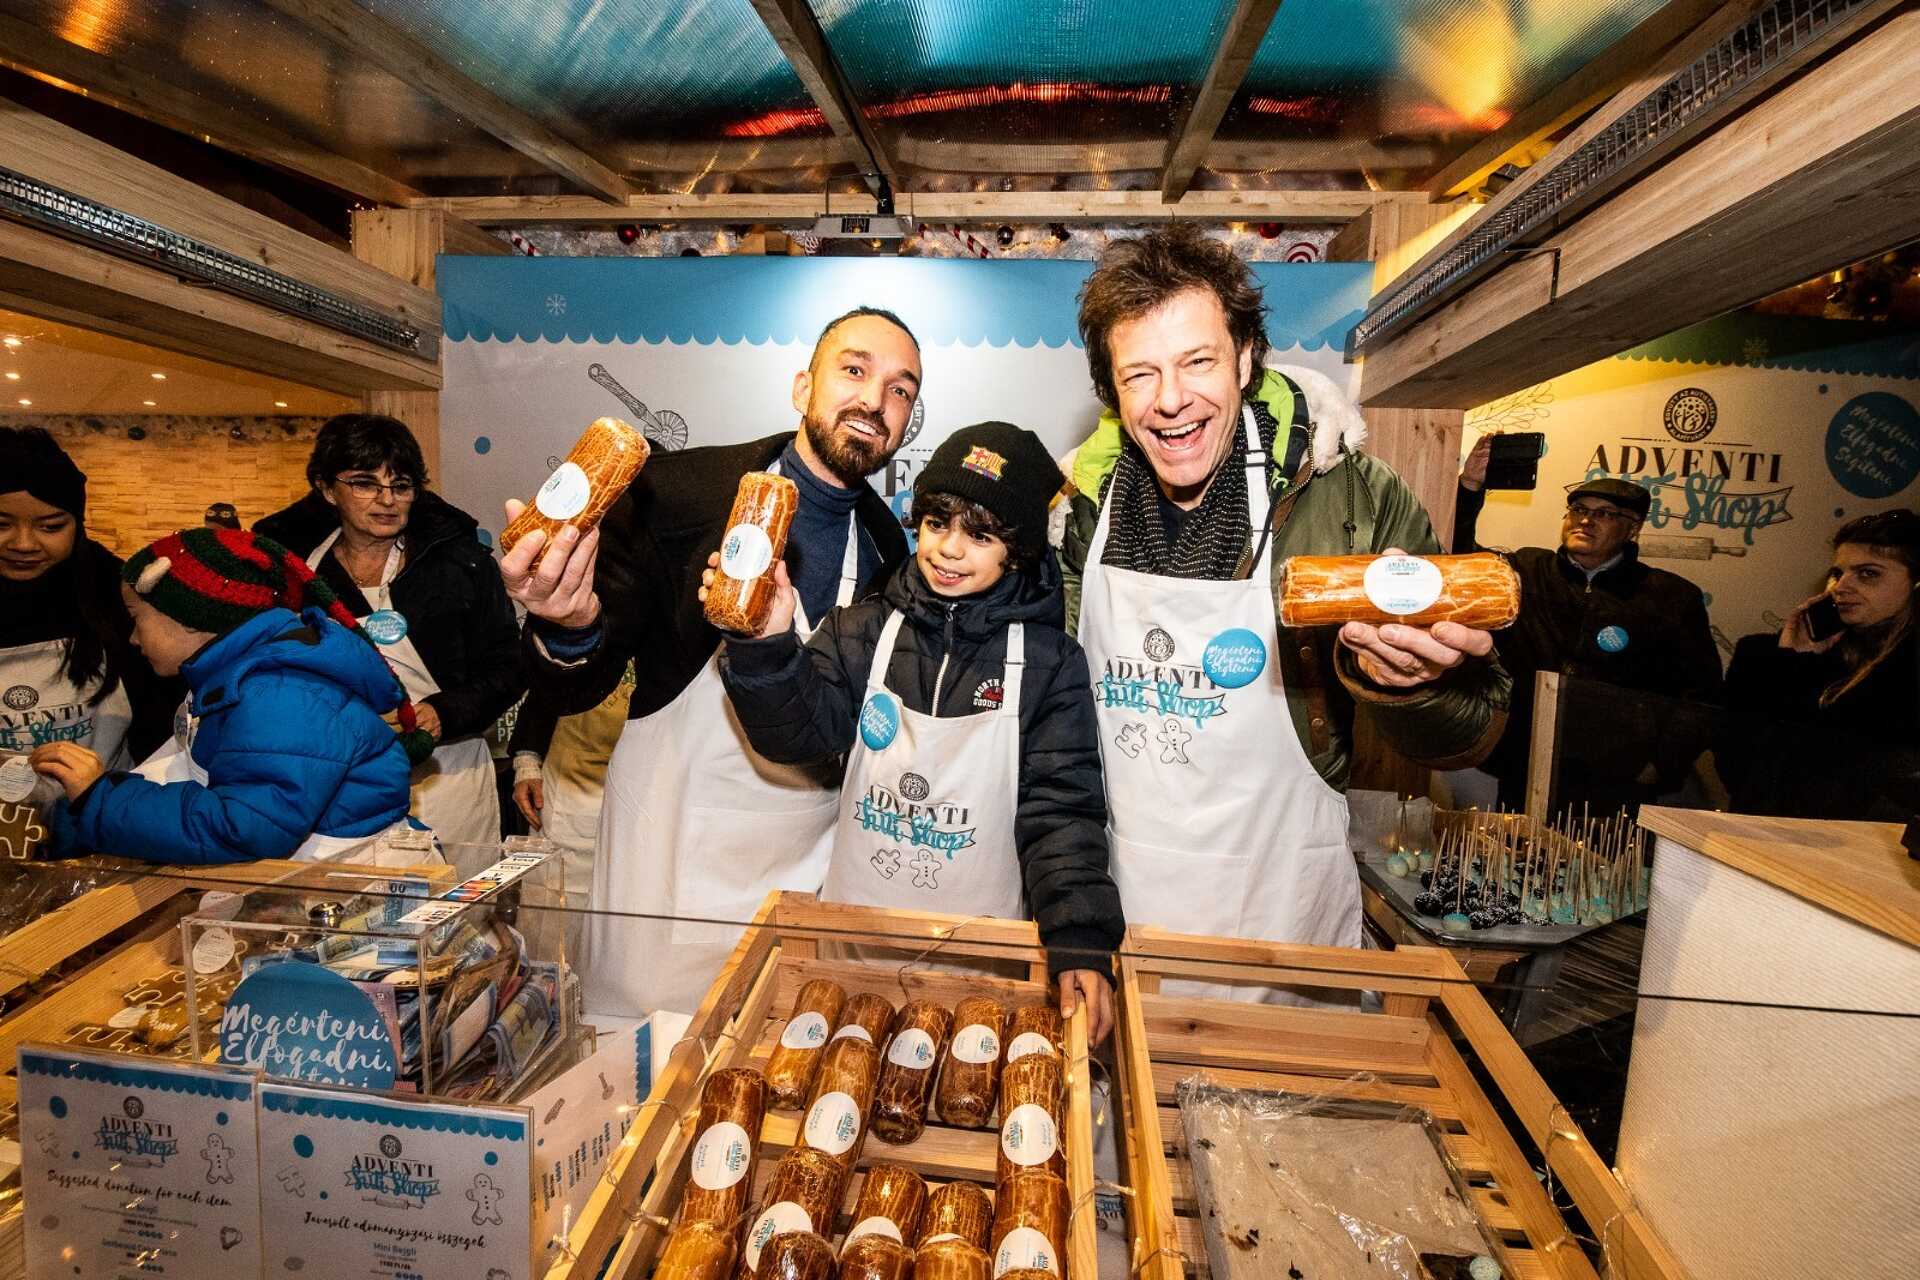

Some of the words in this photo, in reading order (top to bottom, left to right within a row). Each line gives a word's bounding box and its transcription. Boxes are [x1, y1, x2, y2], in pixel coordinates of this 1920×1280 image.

[1585, 444, 1784, 483] ADVENTI
[1682, 468, 1784, 545] Shop
[974, 679, 1000, 698] NORTH
[1157, 681, 1220, 729] Shop
[0, 704, 83, 727] VENTI
[221, 1003, 390, 1046] Megérteni.
[224, 1032, 392, 1077] Elfogadni.
[100, 1116, 172, 1138] ADVENTI
[352, 1155, 433, 1177] ADVENTI
[47, 1169, 99, 1189] Suggested
[105, 1179, 153, 1196] donation
[155, 1186, 173, 1200] for
[177, 1190, 202, 1203] each
[206, 1197, 232, 1206] item
[304, 1211, 350, 1230] Javasolt
